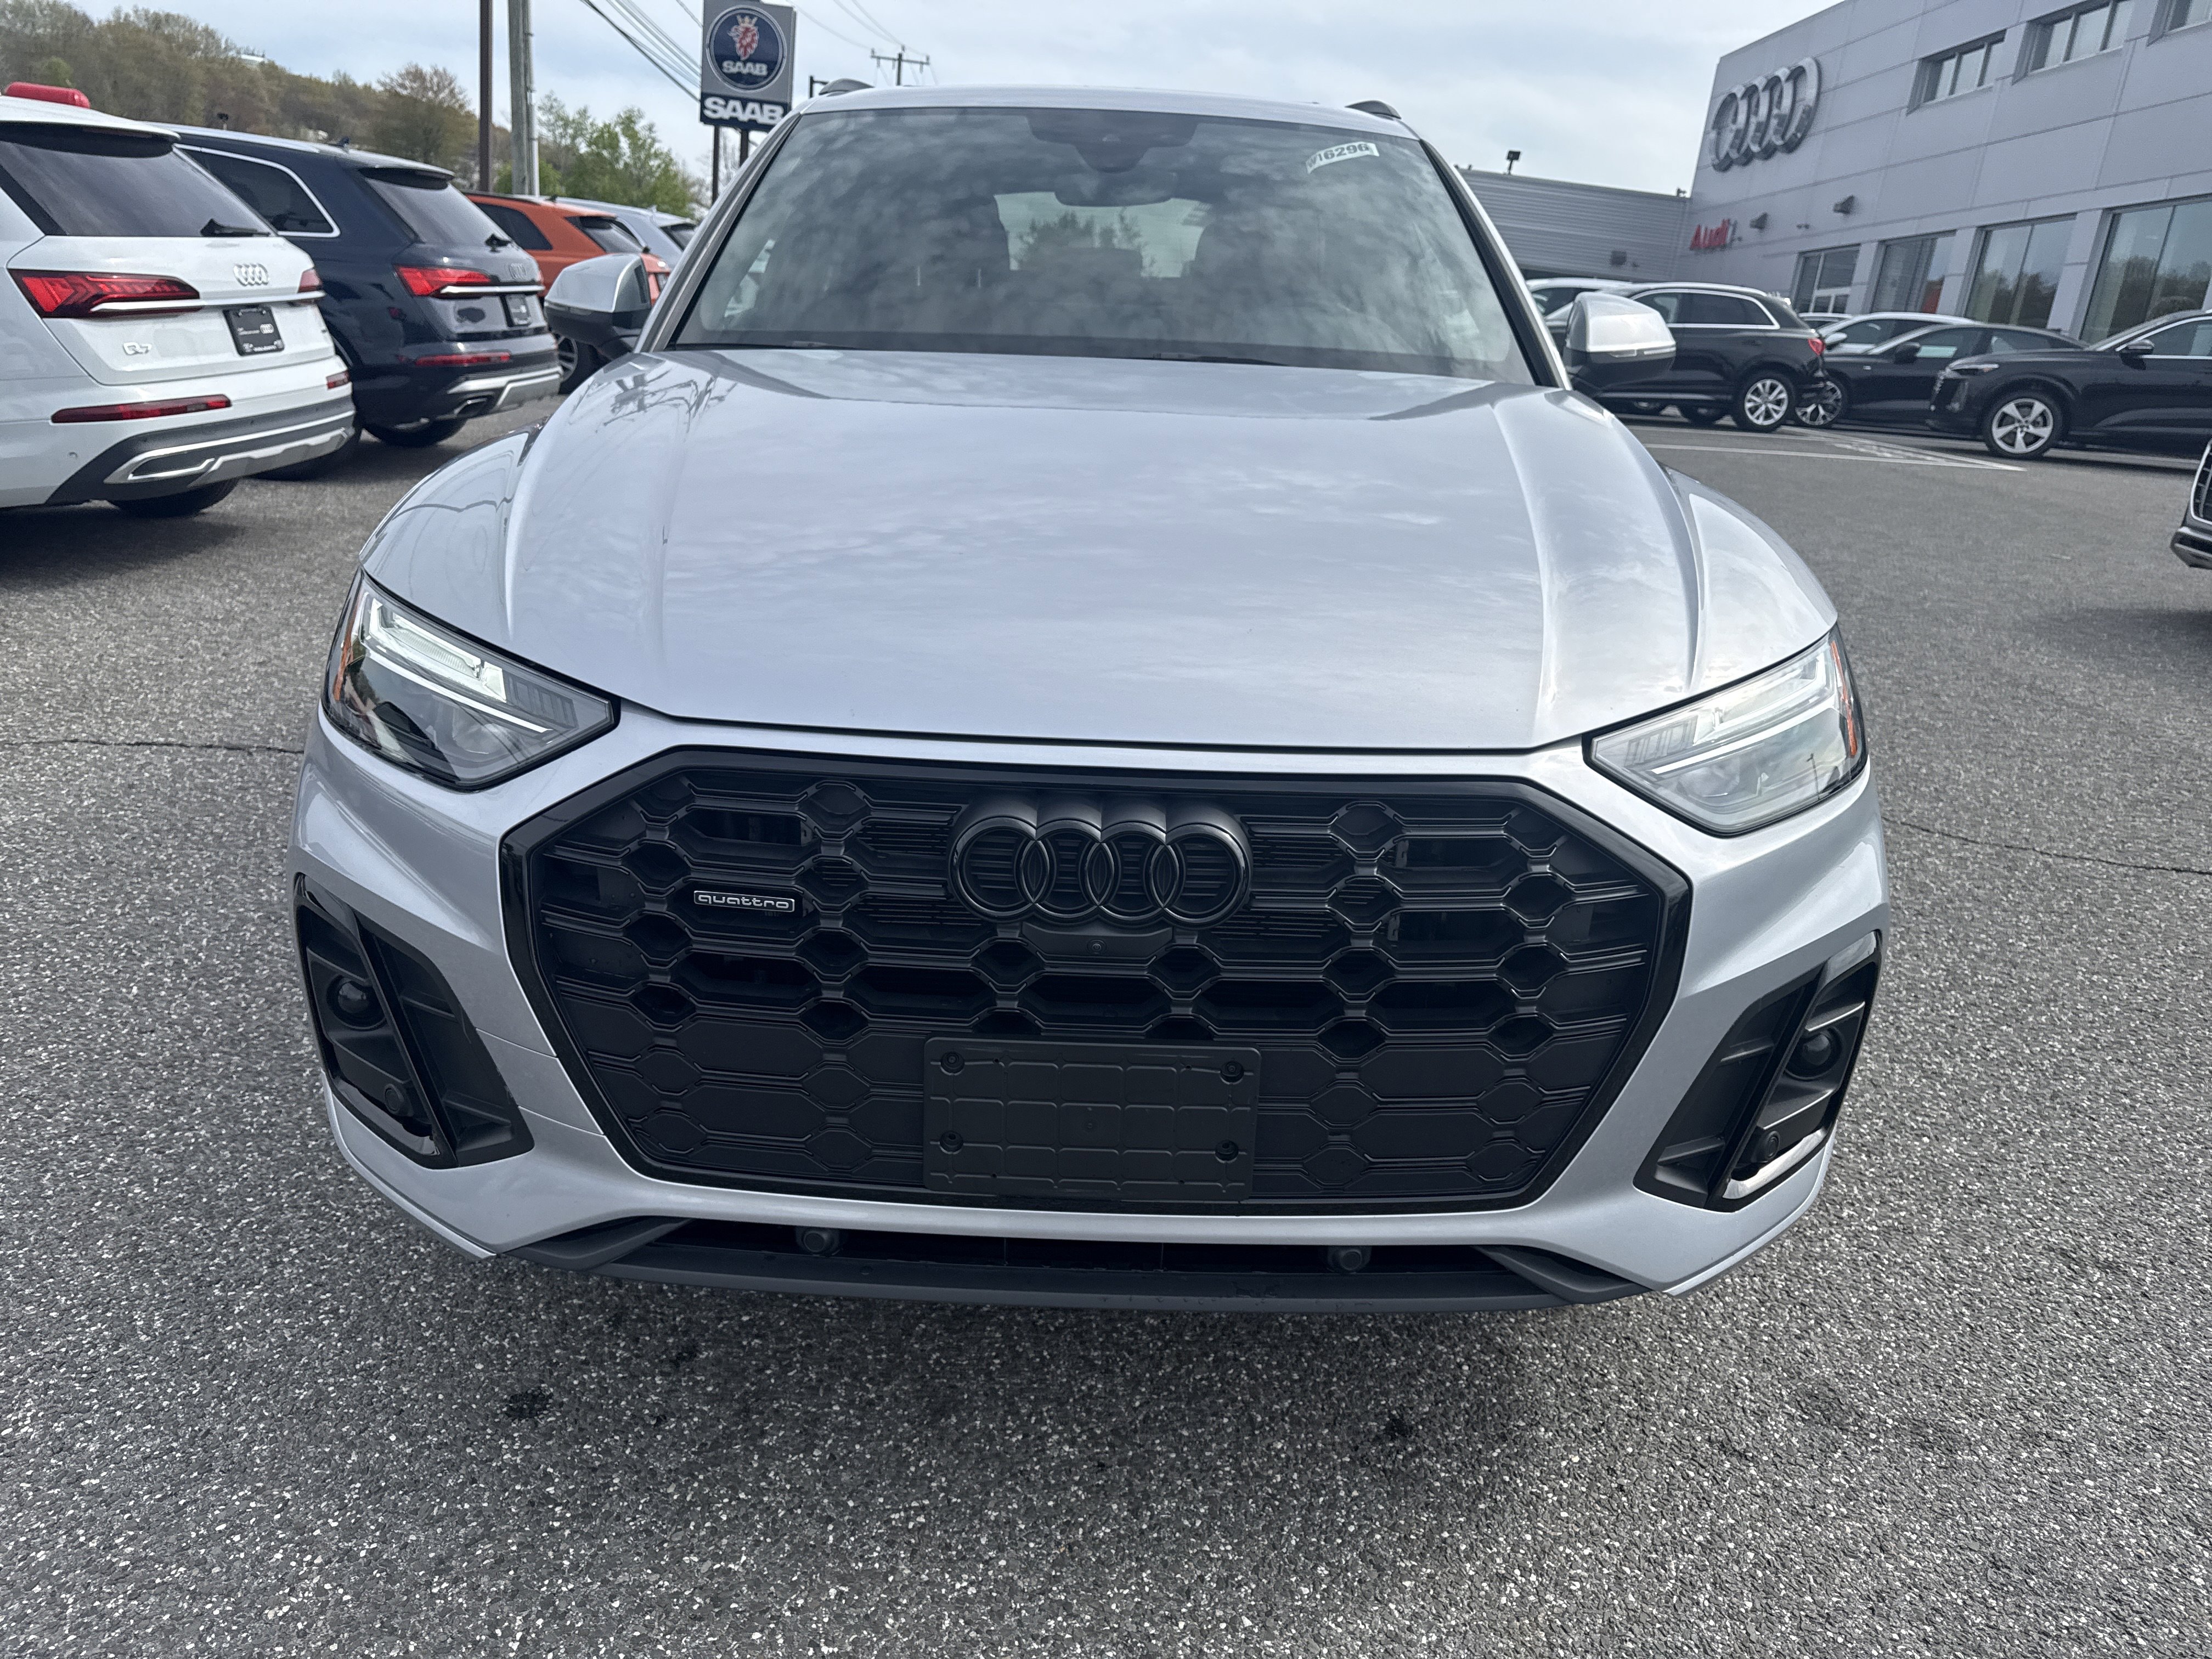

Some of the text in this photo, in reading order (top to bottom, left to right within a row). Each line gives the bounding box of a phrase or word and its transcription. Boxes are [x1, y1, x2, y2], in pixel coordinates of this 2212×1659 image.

[722, 60, 768, 76] SAAB
[703, 97, 783, 126] SAAB
[1690, 218, 1730, 249] Audi
[698, 894, 789, 909] quattro
